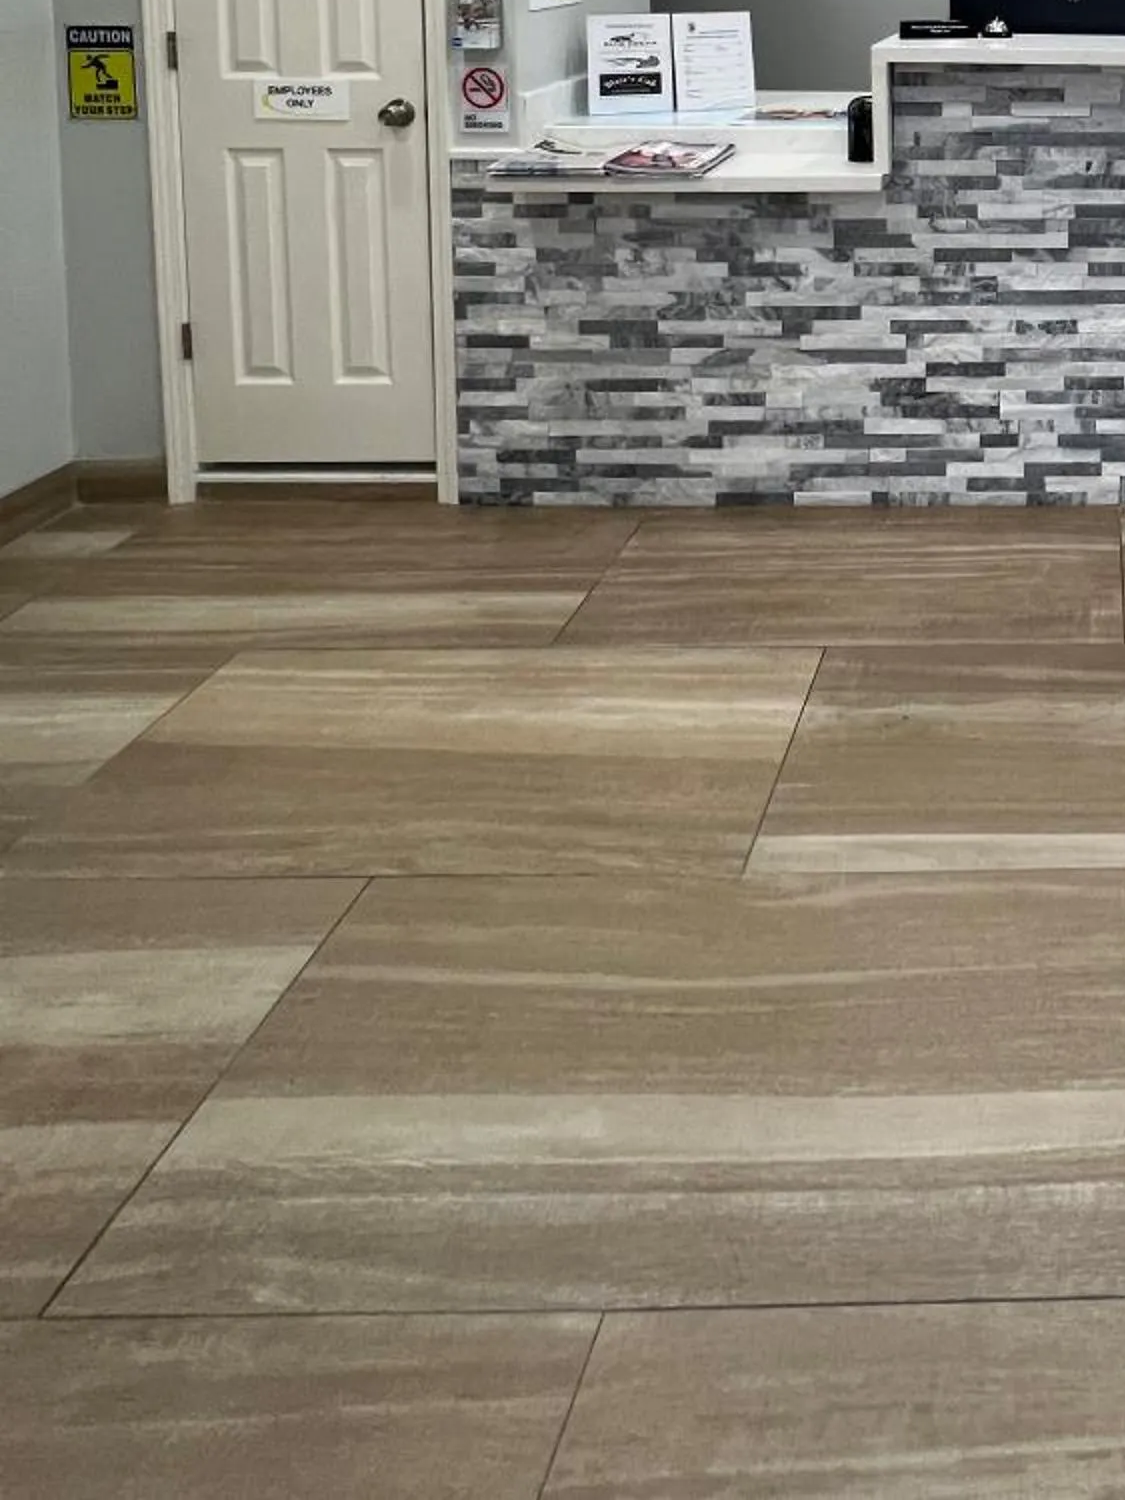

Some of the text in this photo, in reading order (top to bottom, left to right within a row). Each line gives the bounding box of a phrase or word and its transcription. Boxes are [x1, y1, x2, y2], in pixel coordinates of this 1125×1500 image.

[69, 30, 131, 43] CAUTION
[267, 85, 333, 97] EMPLOYEES
[84, 93, 121, 103] WATCH
[286, 99, 315, 109] ONLY
[74, 105, 133, 115] YOUR STEP
